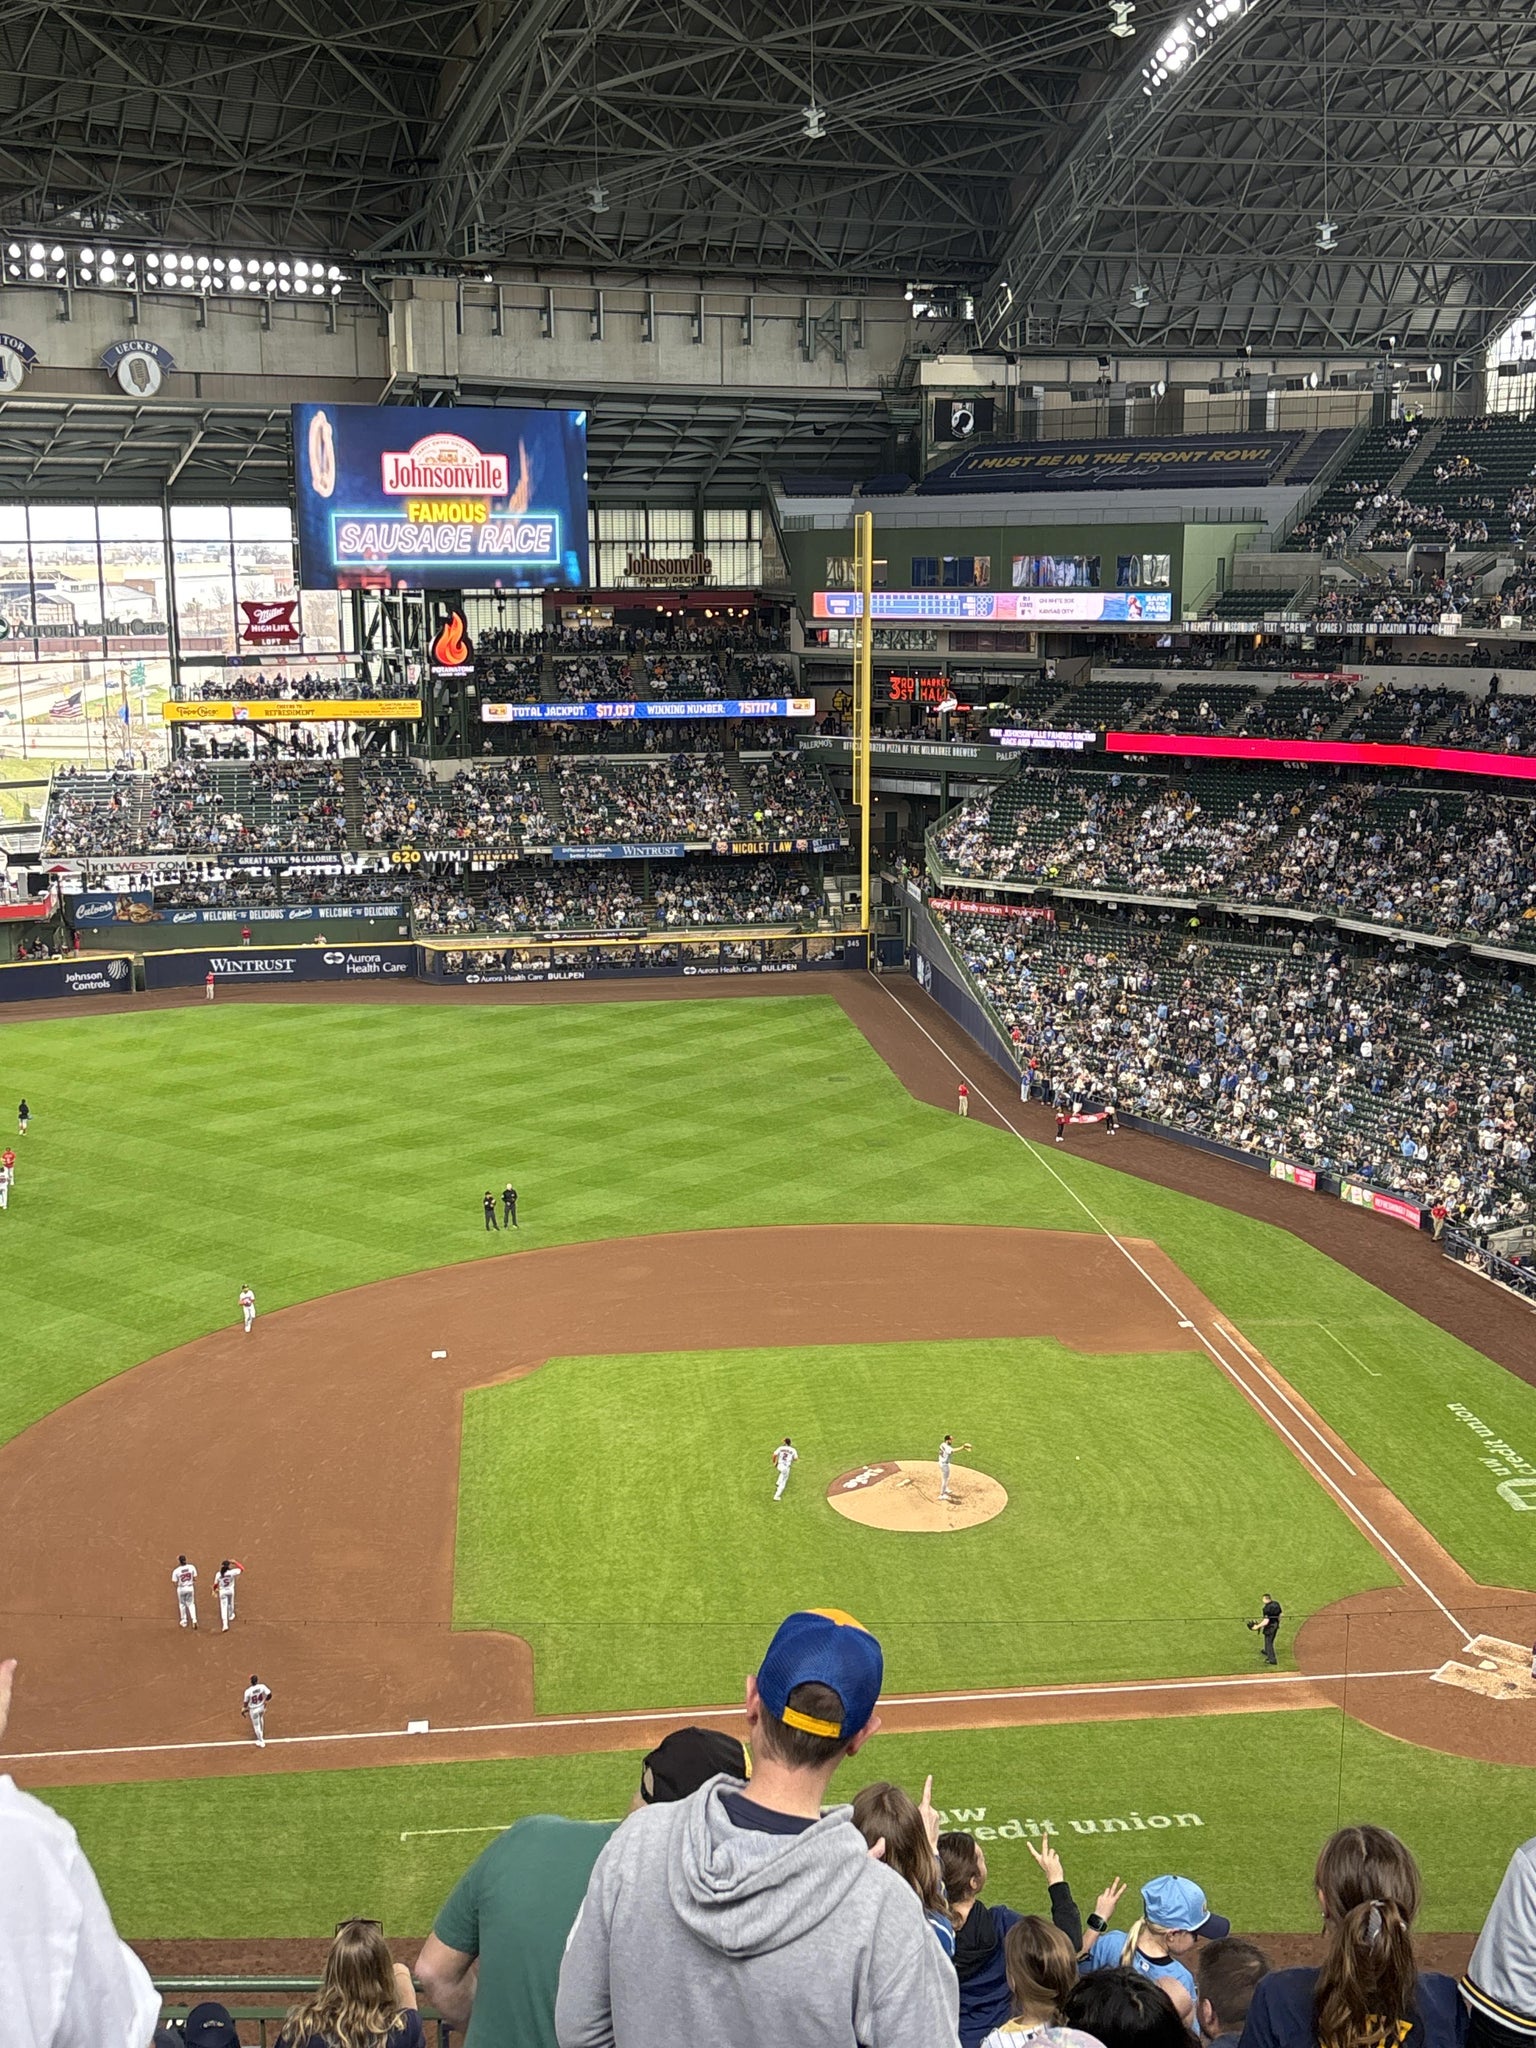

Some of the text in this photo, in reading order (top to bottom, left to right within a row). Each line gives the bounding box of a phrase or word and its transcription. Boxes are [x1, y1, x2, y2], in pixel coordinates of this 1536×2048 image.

[115, 341, 159, 355] UECKER
[968, 449, 1272, 469] I MUST BE IN THE FRONT ROW!
[389, 457, 502, 489] Johnsonville
[408, 502, 487, 523] FAMOUS
[339, 524, 553, 554] SAUSAGE RACE
[624, 552, 712, 576] Johnsonville
[254, 607, 285, 623] Miller
[16, 617, 168, 638] Aurora Health Care
[251, 624, 290, 632] HIGH LIFE
[1190, 621, 1211, 632] REPORT
[1263, 622, 1278, 633] TEXT
[1346, 623, 1365, 634] ISSUE
[1365, 623, 1378, 634] AND
[1379, 623, 1407, 634] LOCATION
[1409, 623, 1417, 634] TO
[920, 677, 950, 686] MARKET
[900, 689, 914, 700] ST
[265, 709, 315, 717] REFRESHMENT
[513, 706, 542, 717] TOTAL
[545, 704, 587, 717] JACKPOT:
[596, 703, 636, 718] $17,037
[647, 703, 686, 715] WINNING
[687, 702, 726, 714] NUMBER:
[738, 701, 778, 714] 7517174
[902, 744, 909, 754] OF
[910, 745, 920, 754] THE
[921, 745, 951, 756] MILWAUKEE
[953, 747, 978, 757] BREWERS
[622, 845, 677, 856] WINTRUST
[732, 841, 793, 854] NICOLET LAW
[238, 856, 262, 865] GREAT
[264, 856, 288, 864] TASTE.
[290, 855, 300, 864] 96
[302, 855, 339, 864] CALORIES.
[392, 850, 469, 863] 620 WTMJ
[202, 910, 238, 922] WELCOME
[249, 909, 285, 920] DELICIOUS
[318, 907, 353, 919] WELCOME
[364, 906, 398, 917] DELICIOUS
[847, 940, 860, 948] 345
[346, 954, 381, 963] Aurora
[209, 958, 295, 972] WINTRUST
[346, 962, 407, 973] Health Care
[743, 965, 758, 973] Care
[761, 963, 798, 972] BULLPEN
[65, 972, 102, 982] Johnson
[481, 972, 585, 983] Aurora Health Care BULLPEN
[72, 980, 110, 991] Controls
[1446, 1403, 1495, 1437] union
[180, 1572, 192, 1583] 29
[223, 1578, 230, 1587] 5
[1067, 1811, 1206, 1834] union
